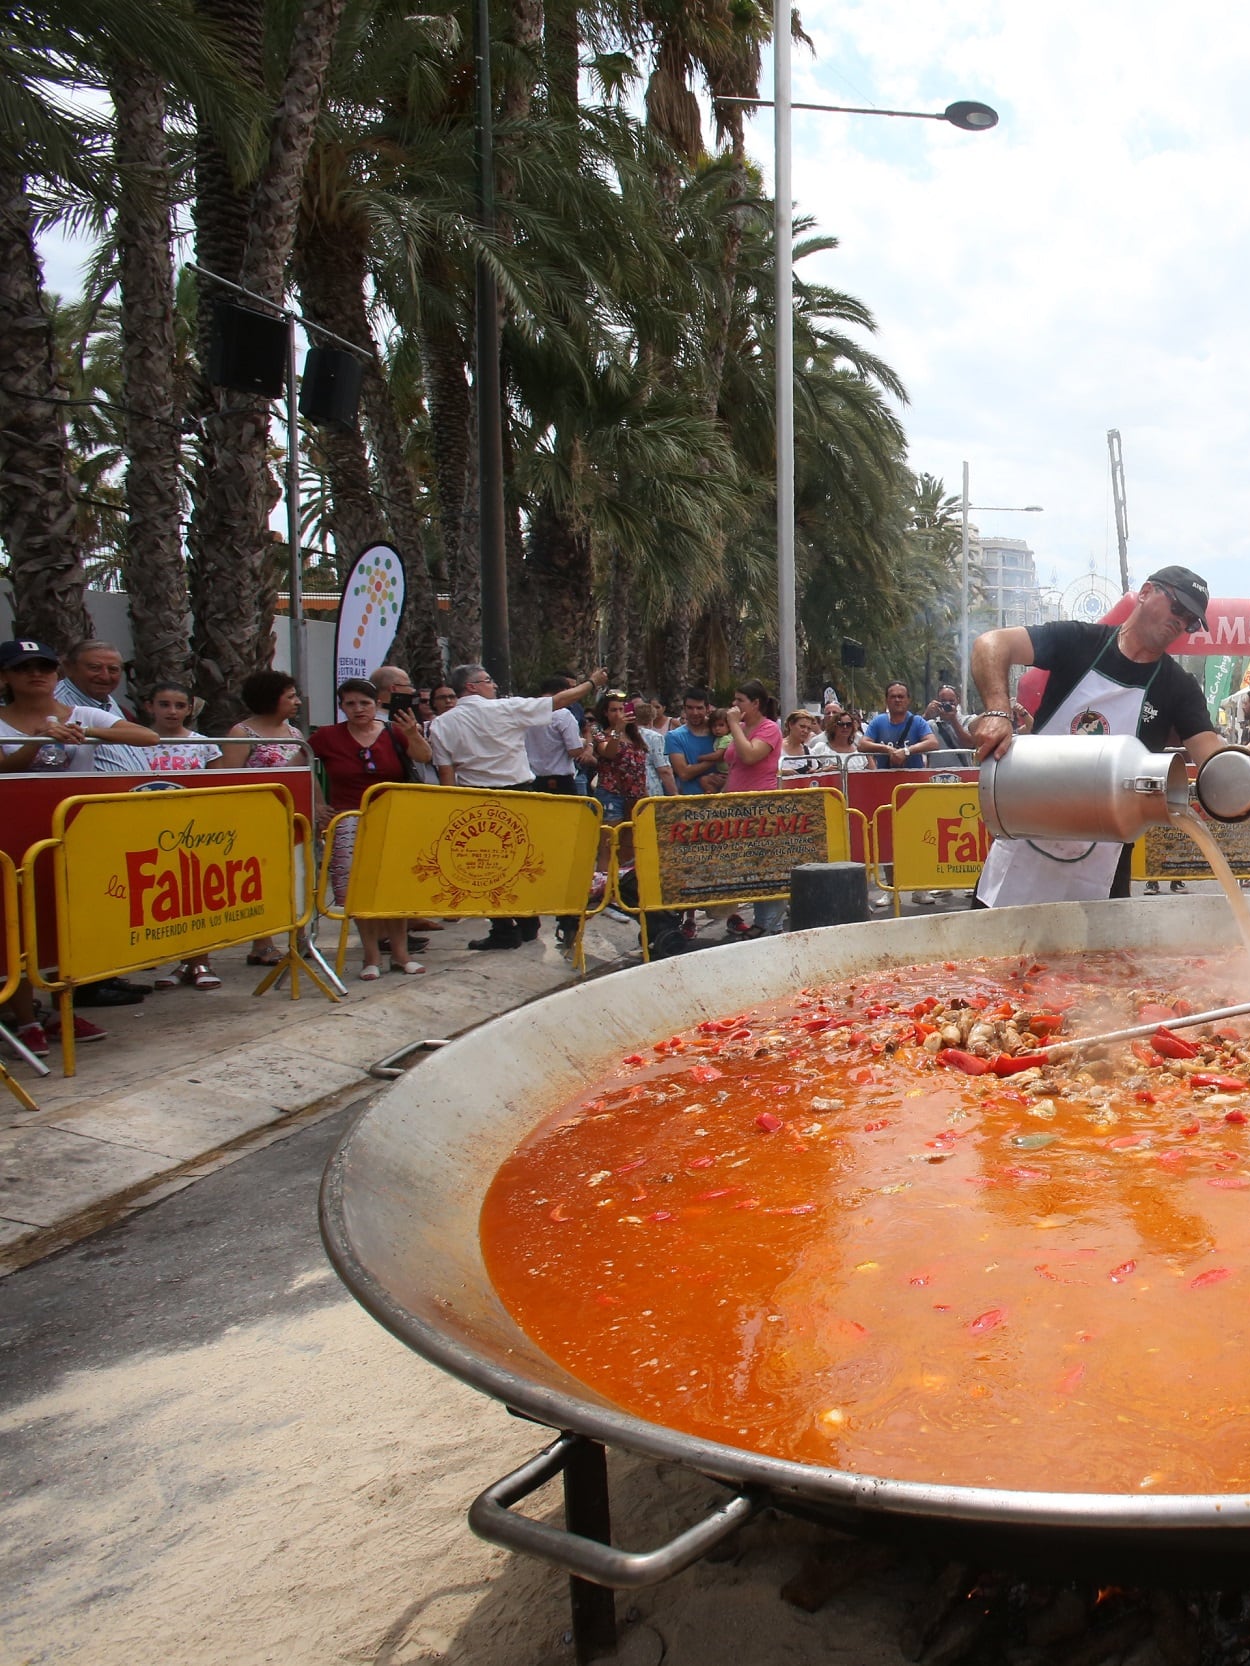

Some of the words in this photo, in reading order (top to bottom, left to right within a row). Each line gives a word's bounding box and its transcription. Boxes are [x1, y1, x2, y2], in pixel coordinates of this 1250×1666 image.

[444, 809, 482, 842] PAELLAS
[487, 808, 526, 845] GIGANTES
[684, 804, 764, 821] RESTAURANTE
[767, 802, 799, 815] CASA
[158, 819, 236, 855] Arroz
[455, 820, 514, 849] RIQUELME
[668, 813, 815, 844] RIQUELME
[104, 875, 127, 899] la
[125, 848, 262, 928] Fallera
[191, 917, 207, 931] POR
